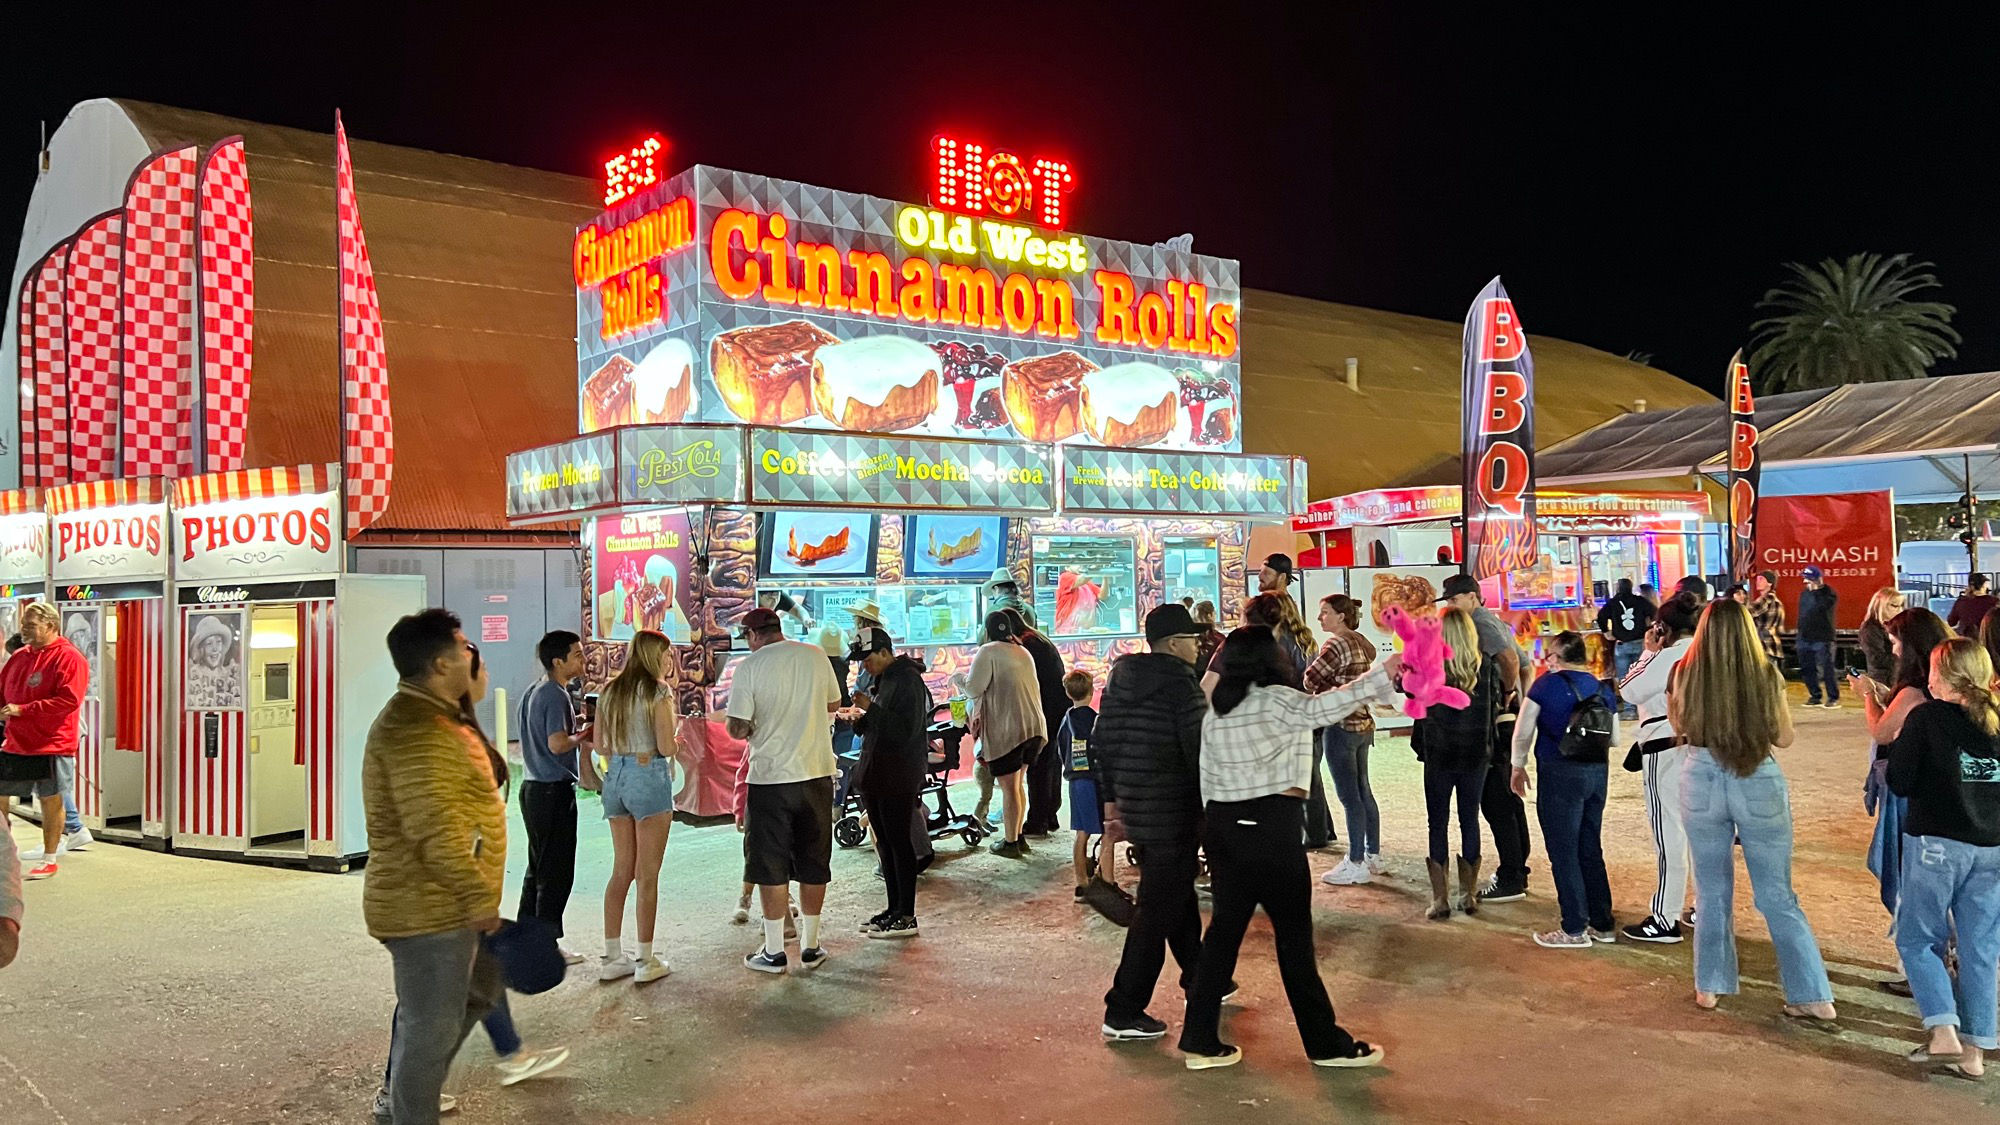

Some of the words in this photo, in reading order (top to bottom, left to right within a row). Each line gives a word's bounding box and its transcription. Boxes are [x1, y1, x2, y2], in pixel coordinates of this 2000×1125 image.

[935, 136, 1074, 228] HOT
[574, 196, 695, 290] Cinnamon
[898, 207, 977, 254] Old
[982, 220, 1087, 273] West
[711, 207, 1079, 340] Cinnamon
[1094, 269, 1237, 358] Rolls
[601, 265, 663, 341] Rolls
[1477, 298, 1530, 520] BBQ
[761, 449, 845, 477] Coffee
[857, 453, 888, 468] Frozen
[857, 460, 894, 480] Blended
[896, 456, 970, 481] Mocha
[1077, 466, 1099, 476] Fresh
[522, 469, 559, 494] Frozen
[562, 459, 600, 486] Mocha
[980, 459, 1043, 484] Cocoa
[1073, 476, 1104, 485] Brewed
[1106, 467, 1143, 488] Iced
[1149, 469, 1178, 489] Tea
[1189, 470, 1226, 491] Cold
[1234, 471, 1280, 492] Water
[1394, 500, 1411, 512] and
[1622, 499, 1640, 510] and
[183, 507, 331, 562] PHOTOS
[621, 517, 637, 535] Old
[59, 514, 161, 563] PHOTOS
[606, 536, 652, 552] Cinnamon
[653, 530, 679, 548] Rolls
[1764, 546, 1879, 563] CHUMASH
[1823, 567, 1878, 577] RESORT
[67, 585, 101, 599] Color
[197, 586, 249, 602] Classic
[825, 597, 840, 605] FAIR
